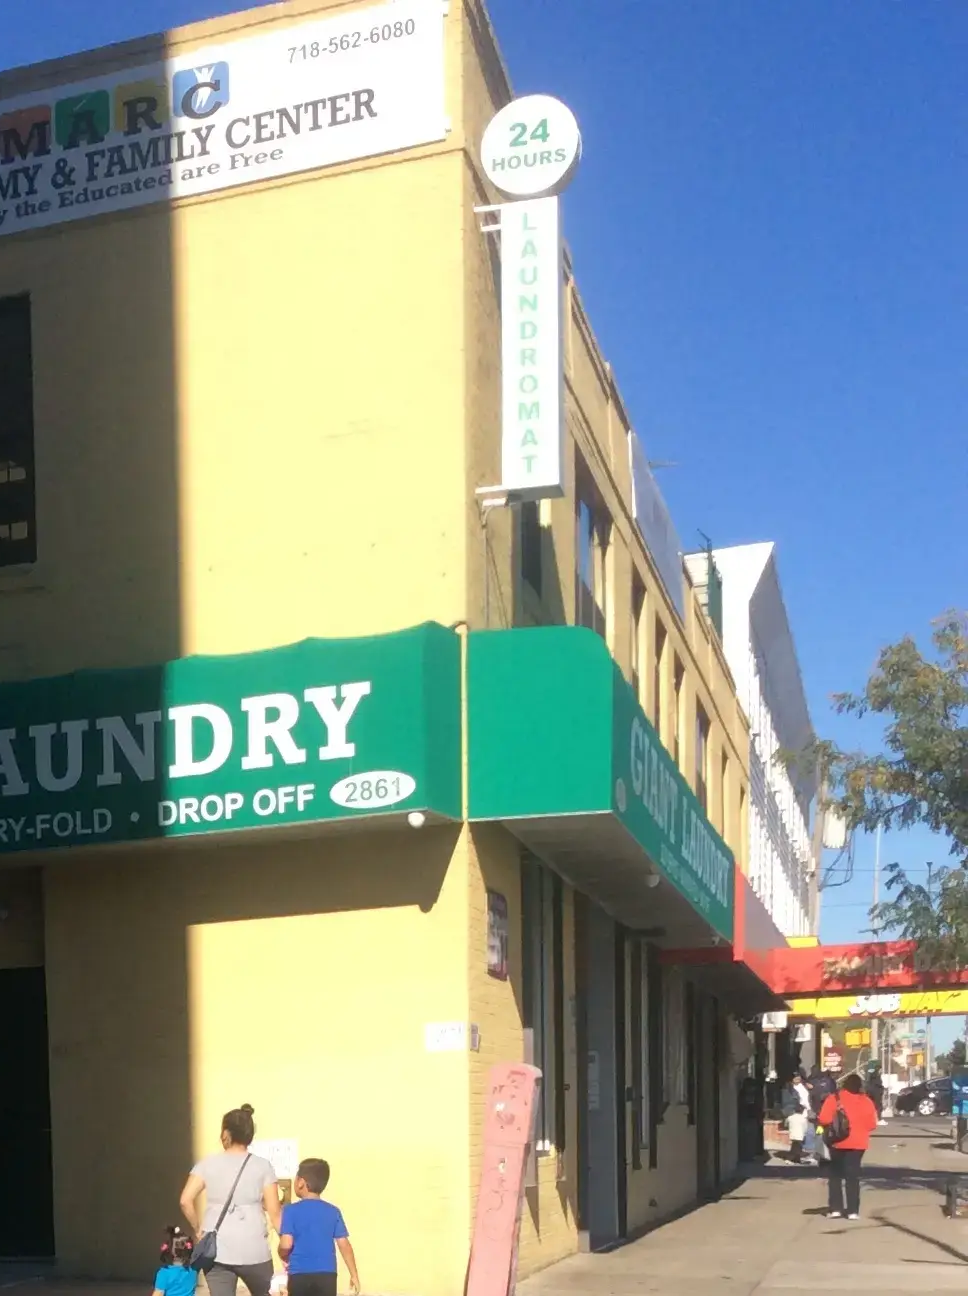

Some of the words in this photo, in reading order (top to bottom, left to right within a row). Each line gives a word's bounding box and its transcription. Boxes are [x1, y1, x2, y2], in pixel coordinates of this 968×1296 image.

[287, 19, 416, 63] 718-562-6080
[0, 80, 223, 166] MARC
[52, 158, 75, 191] &
[86, 124, 215, 183] FAMILY
[225, 88, 378, 149] CENTER
[508, 118, 551, 148] 24
[15, 195, 51, 216] the
[59, 169, 174, 209] Educated
[180, 162, 220, 182] are
[229, 146, 284, 170] Free
[491, 148, 567, 173] HOURS
[517, 211, 541, 474] LAUNDROMAT
[157, 791, 244, 827] DROP
[251, 783, 315, 817] OFF
[342, 776, 403, 805] 2861
[630, 716, 679, 846] GIANT
[681, 796, 731, 909] LAUNDRY
